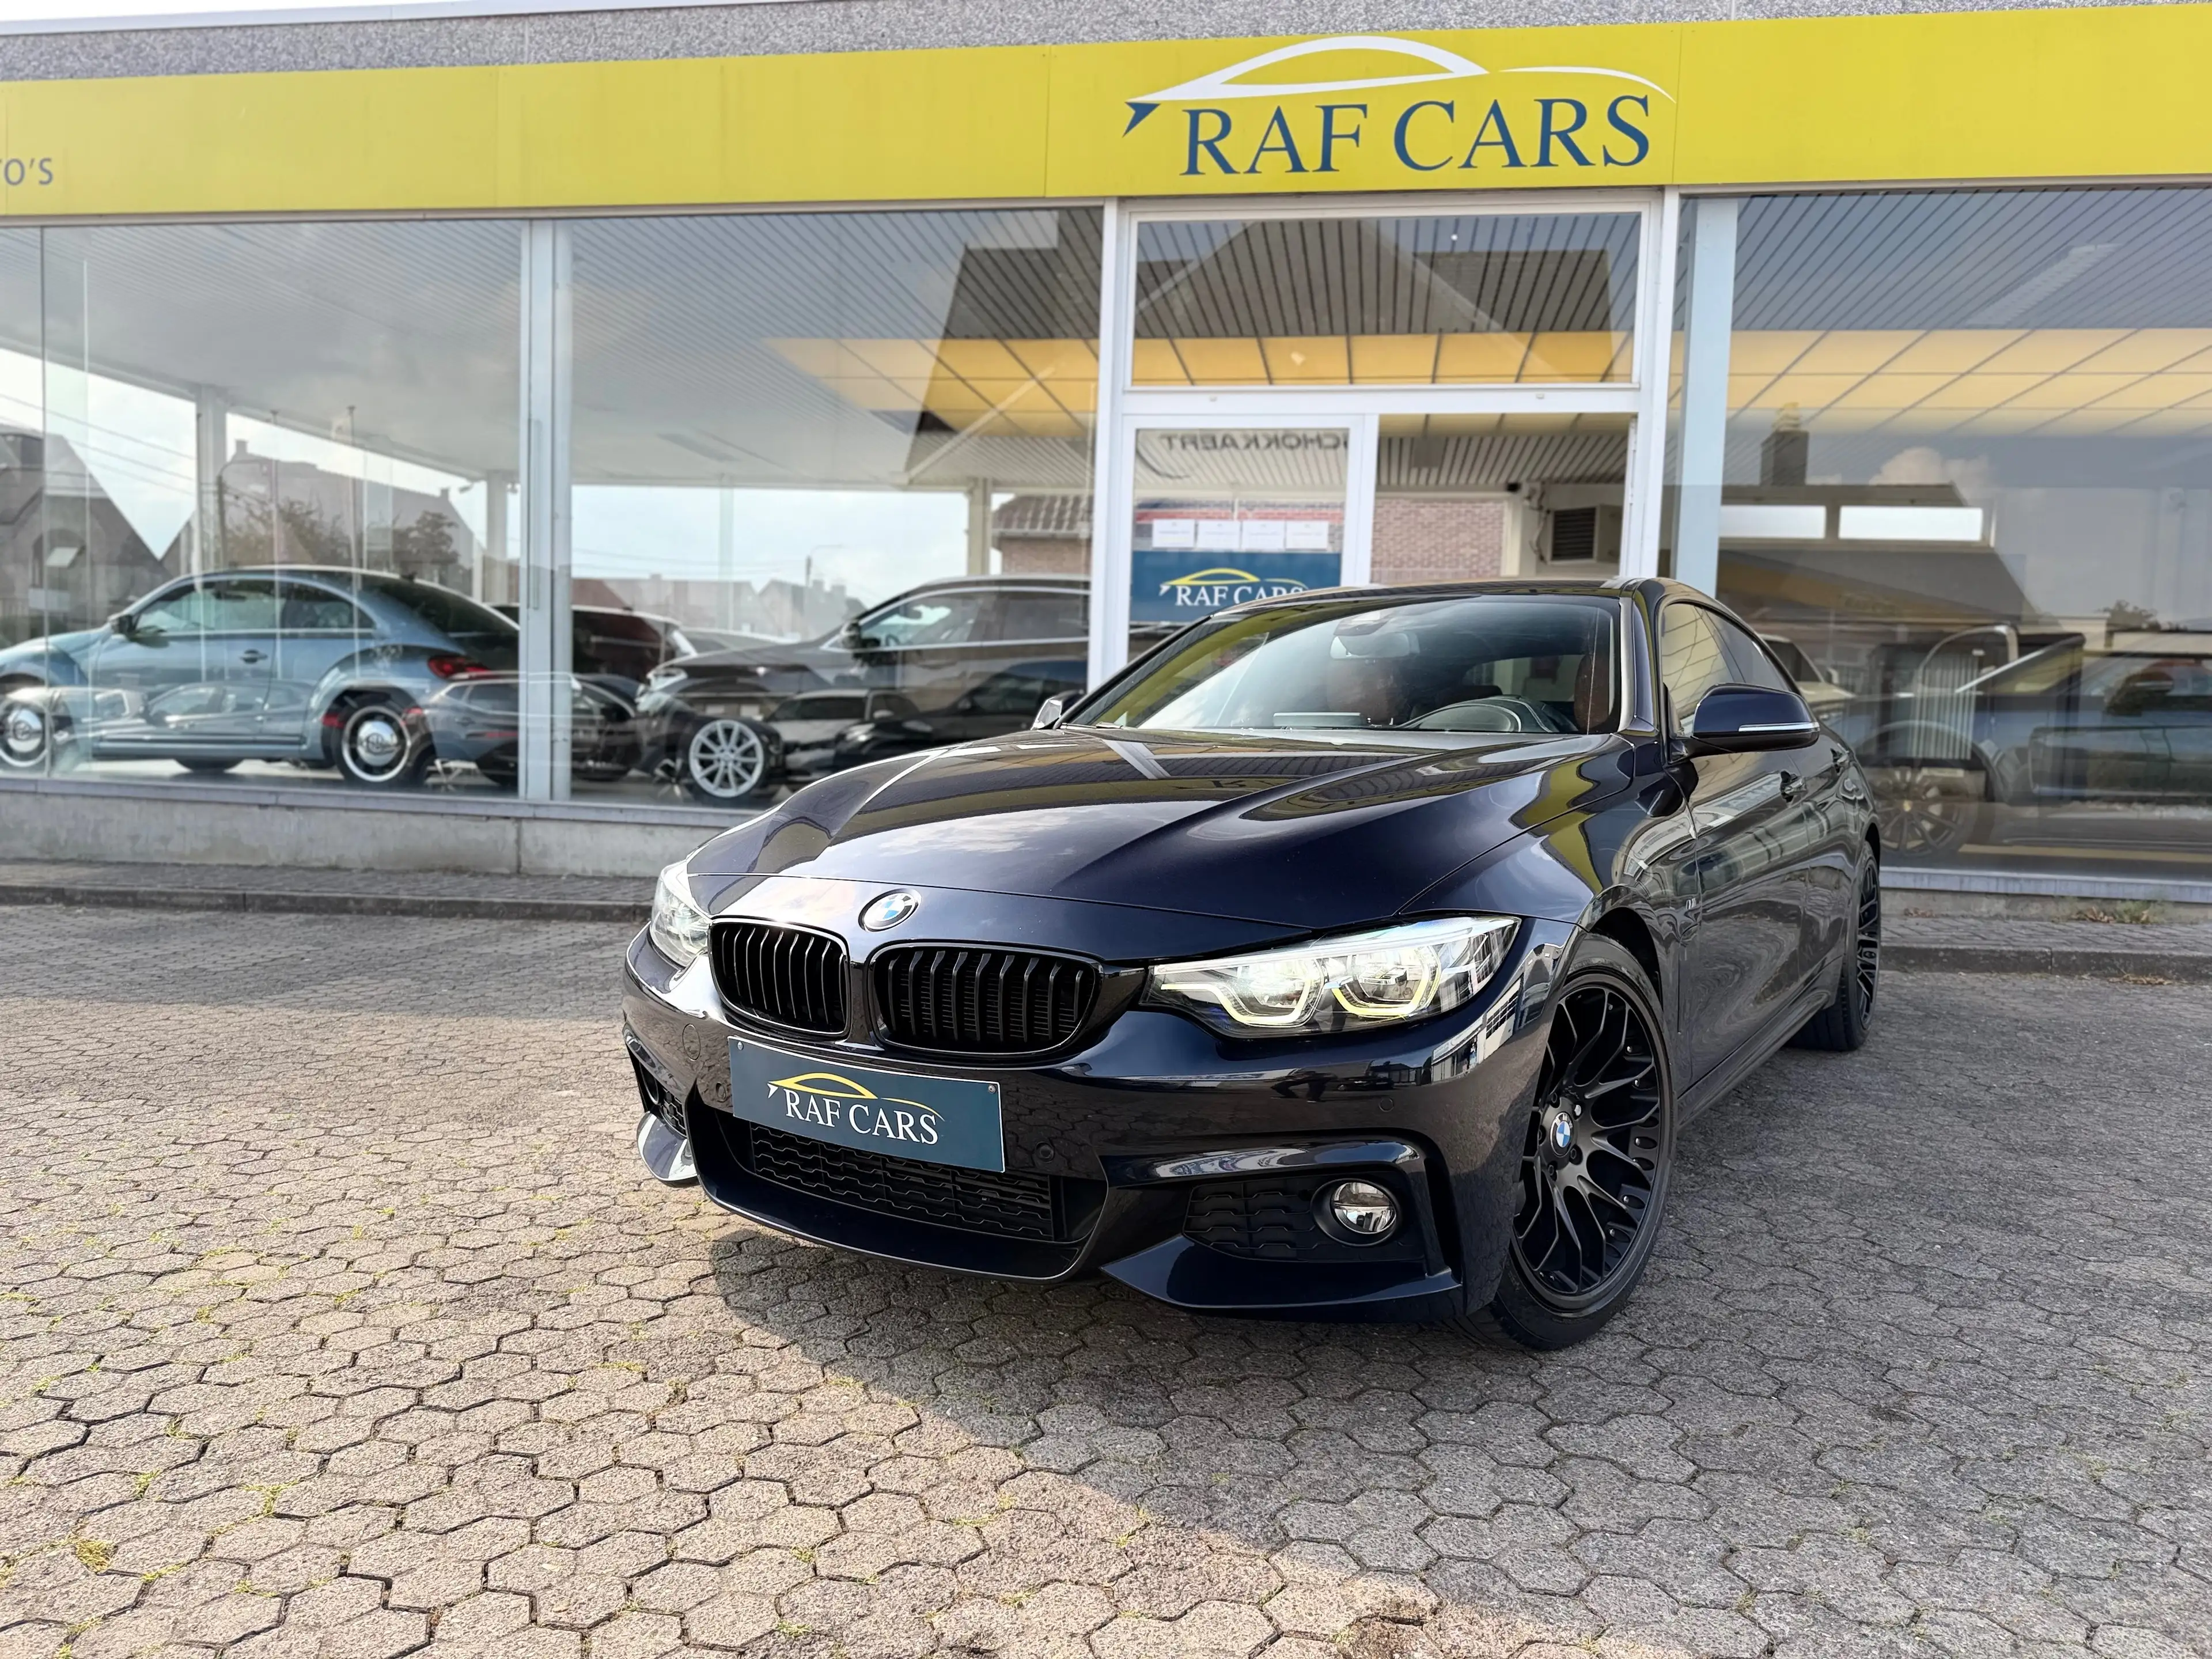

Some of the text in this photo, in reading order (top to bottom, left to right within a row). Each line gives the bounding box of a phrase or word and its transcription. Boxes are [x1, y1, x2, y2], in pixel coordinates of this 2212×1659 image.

[1180, 94, 1650, 176] RAF CARS
[0, 158, 53, 185] O'S
[1175, 585, 1228, 607] RAF
[784, 1089, 938, 1145] RAF CARS
